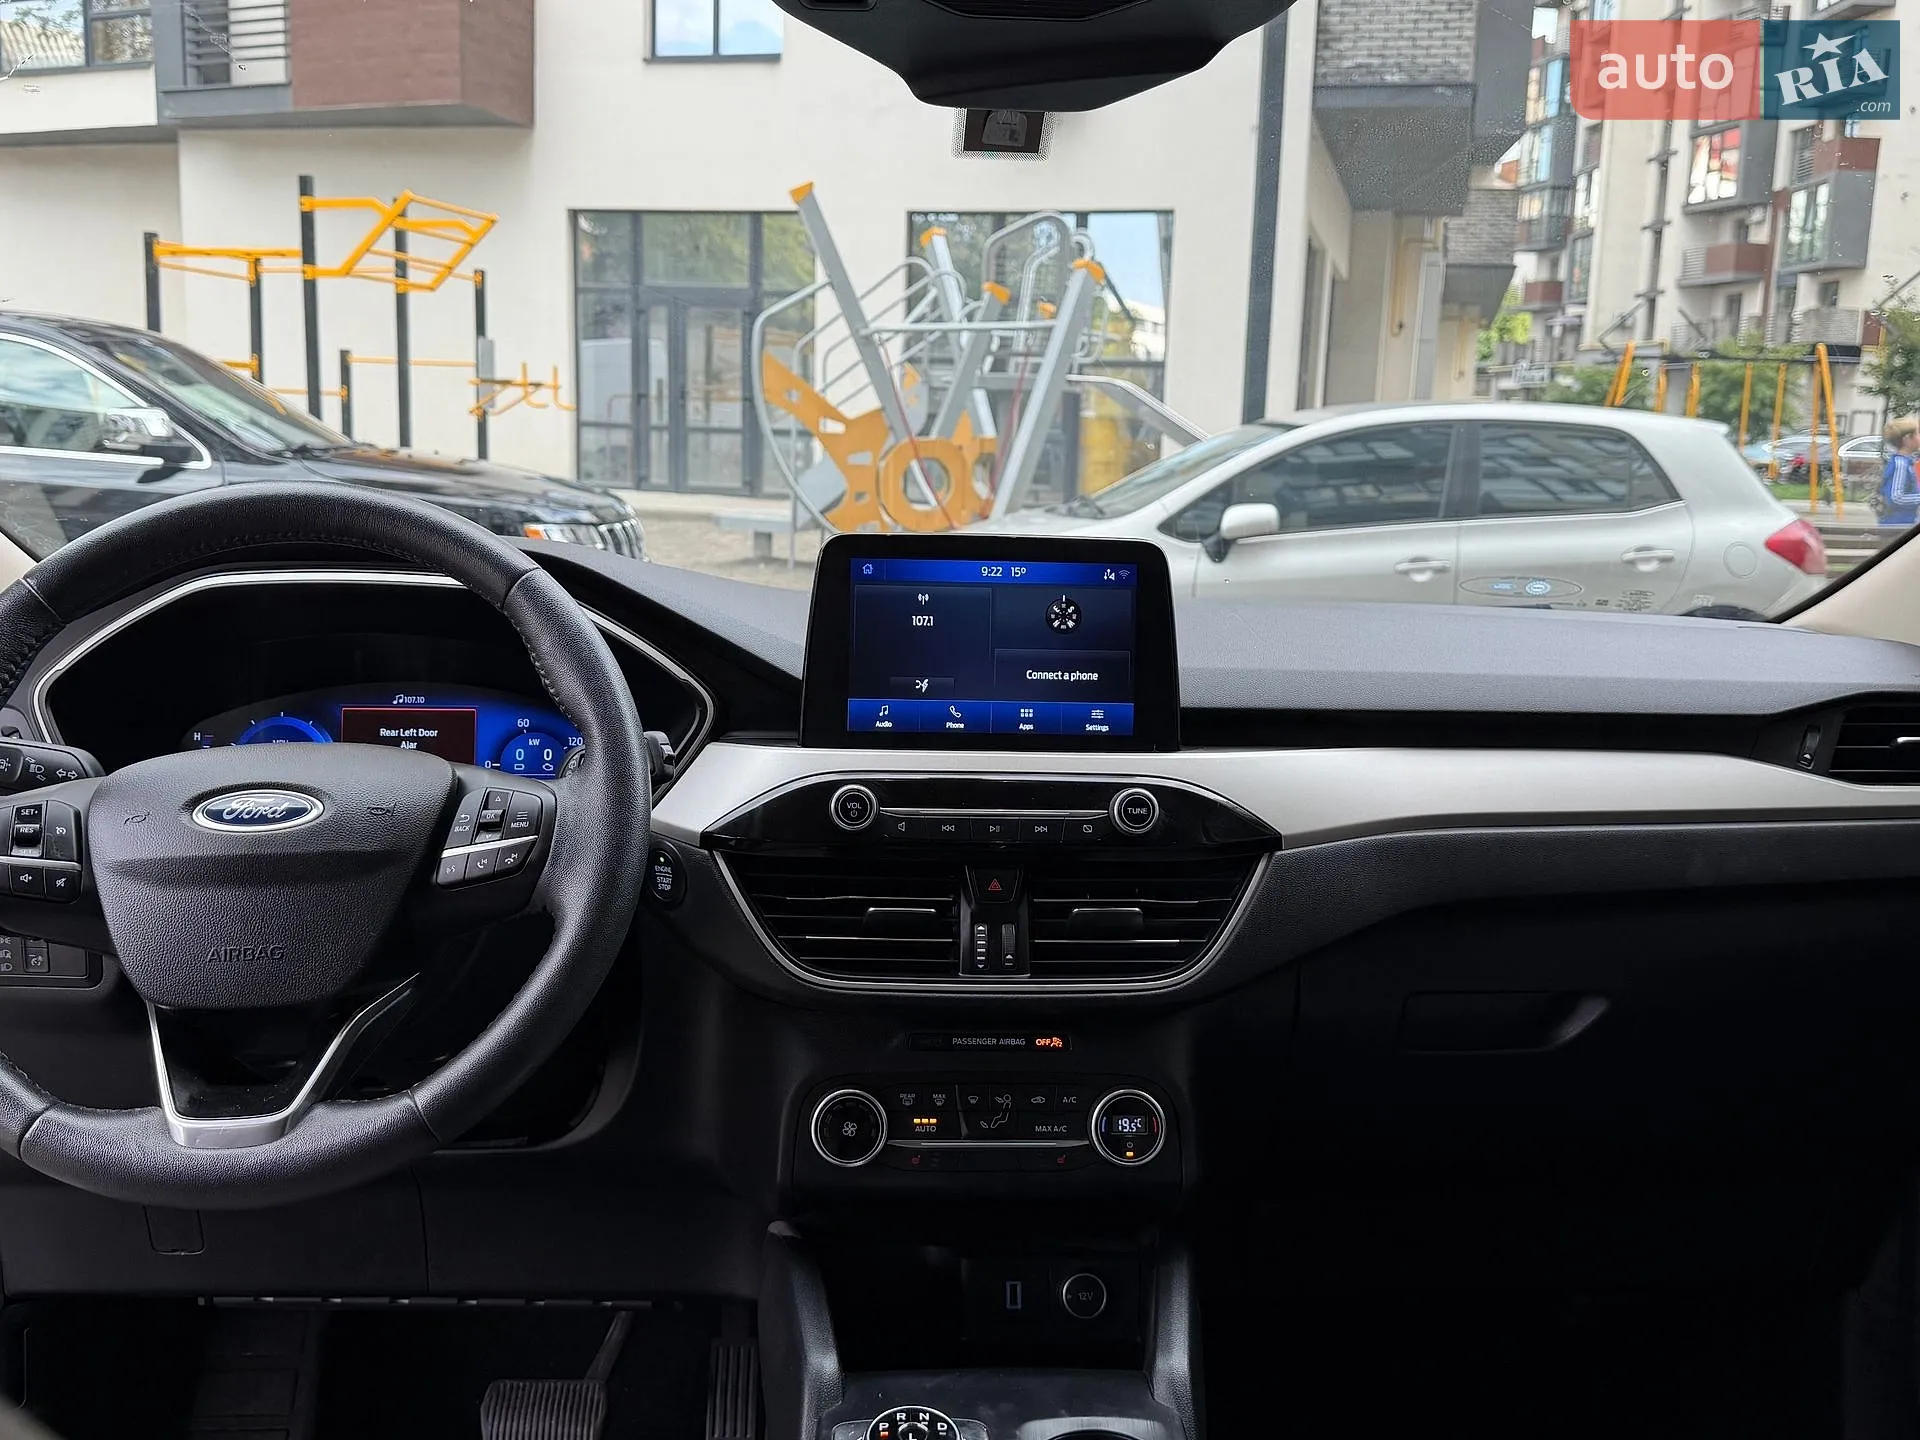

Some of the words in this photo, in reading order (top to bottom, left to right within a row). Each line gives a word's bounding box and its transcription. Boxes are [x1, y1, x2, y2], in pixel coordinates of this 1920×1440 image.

[981, 566, 1003, 577] 9:22
[912, 615, 934, 627] 107.1
[1026, 669, 1062, 681] Connect
[1063, 672, 1069, 681] a
[1070, 670, 1099, 682] phone
[404, 696, 425, 704] 107.10
[517, 718, 530, 728] 60
[875, 720, 893, 728] Audio
[946, 721, 965, 729] Phone
[1018, 723, 1034, 732] Apps
[380, 728, 399, 737] Rear
[400, 728, 417, 737] Left
[418, 728, 439, 737] Door
[1085, 724, 1110, 733] Settings
[400, 740, 418, 750] Ajar
[528, 738, 540, 746] kW
[568, 737, 583, 746] 120
[515, 748, 525, 761] 0
[543, 748, 553, 761] 0
[221, 797, 289, 820] Ford
[846, 802, 862, 810] VOL
[1127, 807, 1149, 815] TUNE
[454, 824, 471, 833] BACK
[510, 821, 530, 829] MENU
[656, 876, 672, 885] START
[657, 883, 672, 891] STOP
[206, 944, 285, 963] AIRBAG
[952, 1037, 998, 1047] PASSENGER
[998, 1037, 1026, 1047] AIRBAG
[1035, 1038, 1051, 1047] OFF
[1062, 1095, 1077, 1104] A/C
[914, 1124, 937, 1133] AUTO
[1034, 1124, 1052, 1133] MAX
[1052, 1124, 1068, 1133] A/C
[896, 1412, 907, 1421] R
[919, 1412, 930, 1421] N
[878, 1422, 890, 1431] P
[937, 1422, 948, 1431] D
